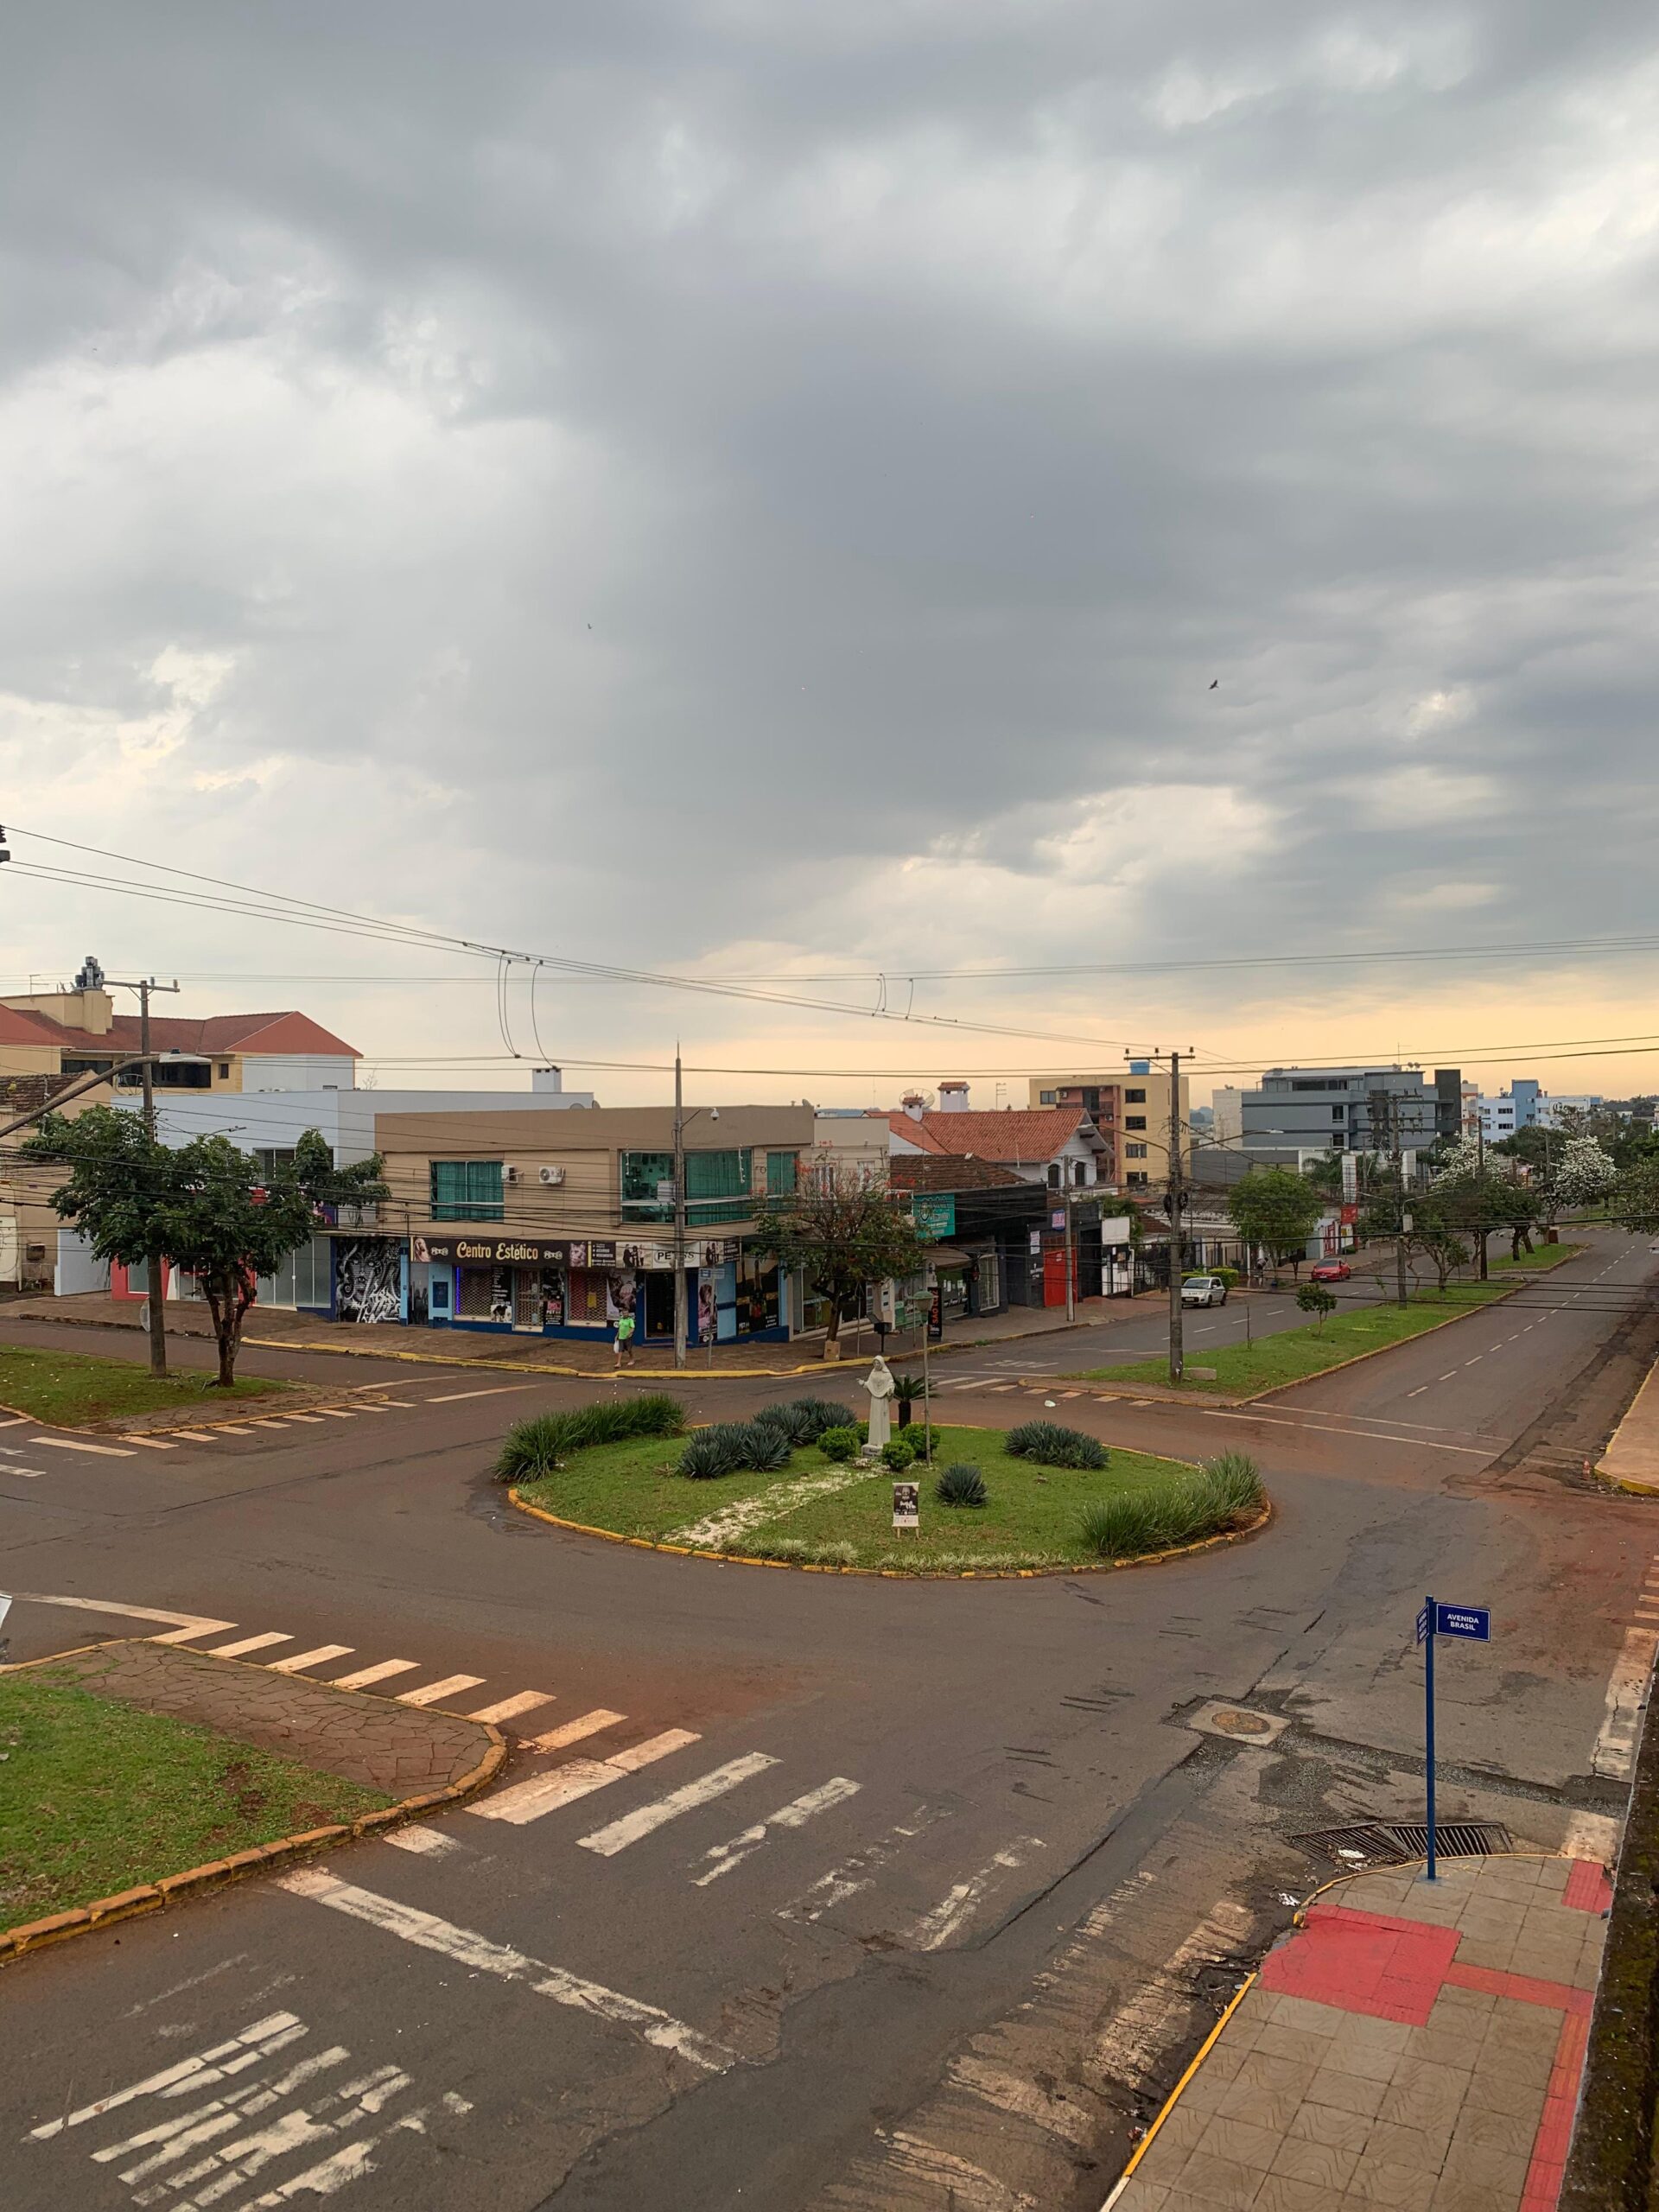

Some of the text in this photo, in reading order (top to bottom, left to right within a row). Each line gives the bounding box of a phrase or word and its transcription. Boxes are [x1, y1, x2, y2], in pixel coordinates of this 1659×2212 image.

[456, 1242, 539, 1260] Centro Estético
[1447, 1613, 1479, 1624] AVENIDA
[1450, 1621, 1476, 1630] BRASIL
